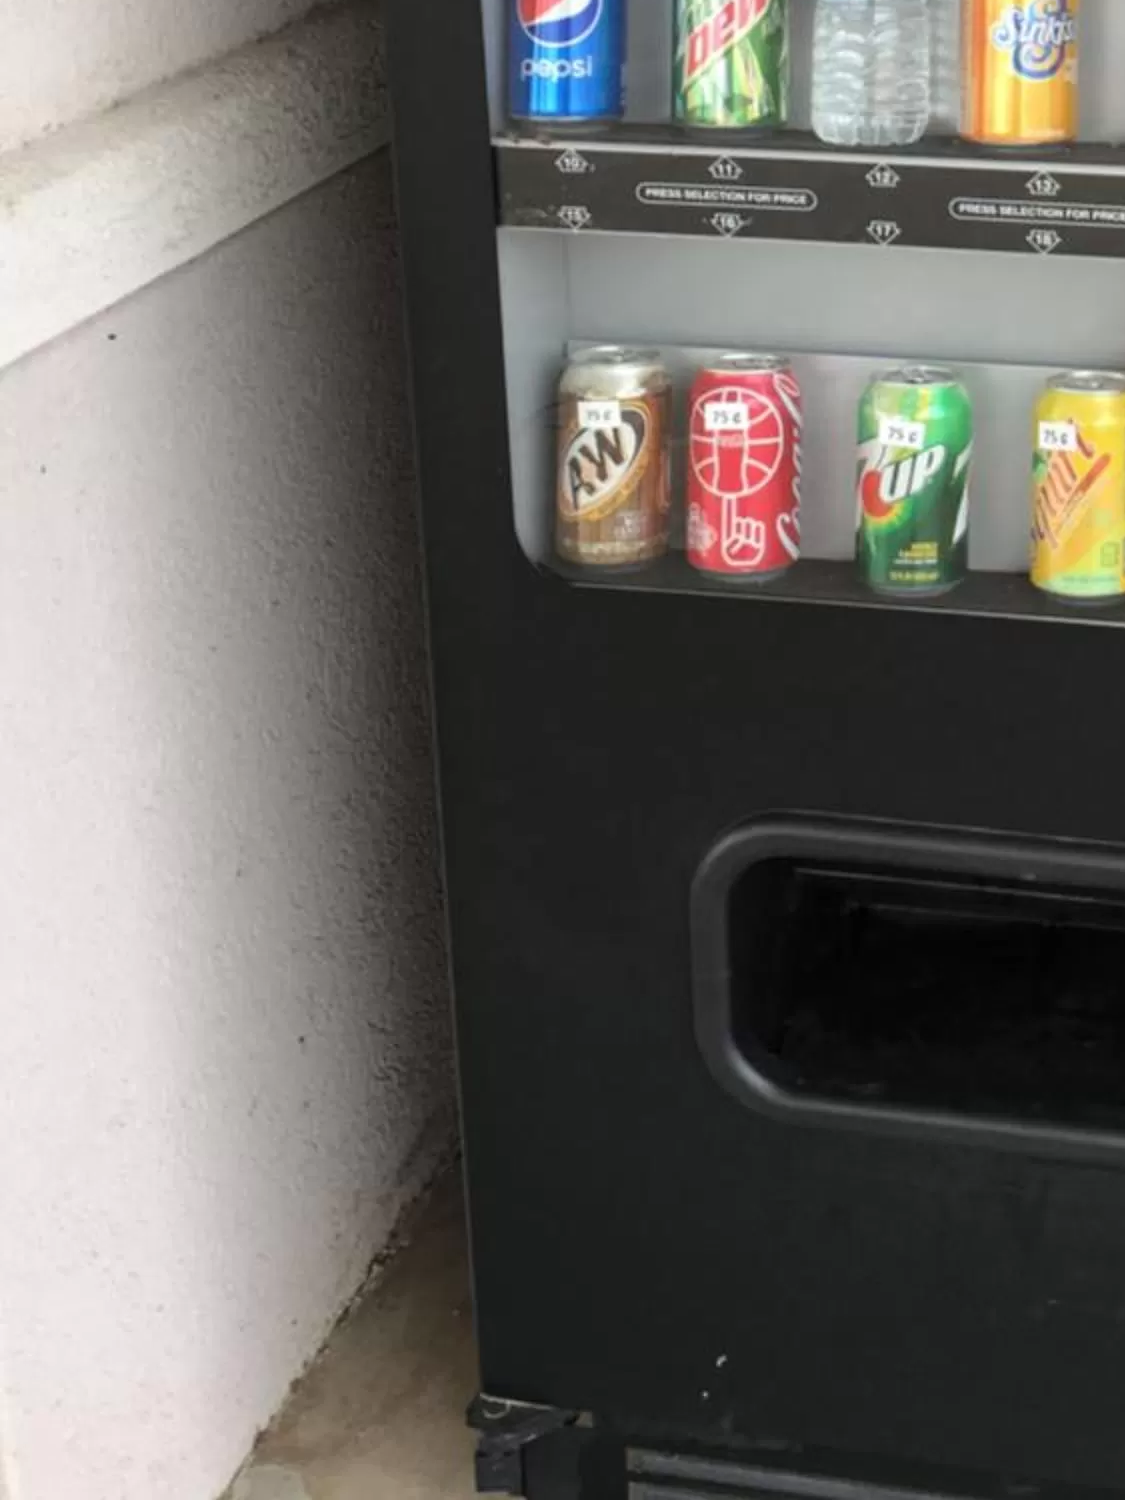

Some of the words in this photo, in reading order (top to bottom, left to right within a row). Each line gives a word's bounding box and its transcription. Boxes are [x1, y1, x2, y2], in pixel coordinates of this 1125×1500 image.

[521, 56, 593, 84] pepsi
[645, 187, 681, 199] PRESS
[683, 188, 746, 201] SELECTION
[748, 191, 771, 203] FOR
[773, 193, 806, 205] PRICE
[959, 202, 996, 214] PRESS
[1000, 204, 1063, 217] SELECTION
[1066, 208, 1090, 219] FOR
[1092, 210, 1125, 222] PRICE
[874, 223, 890, 236] 17
